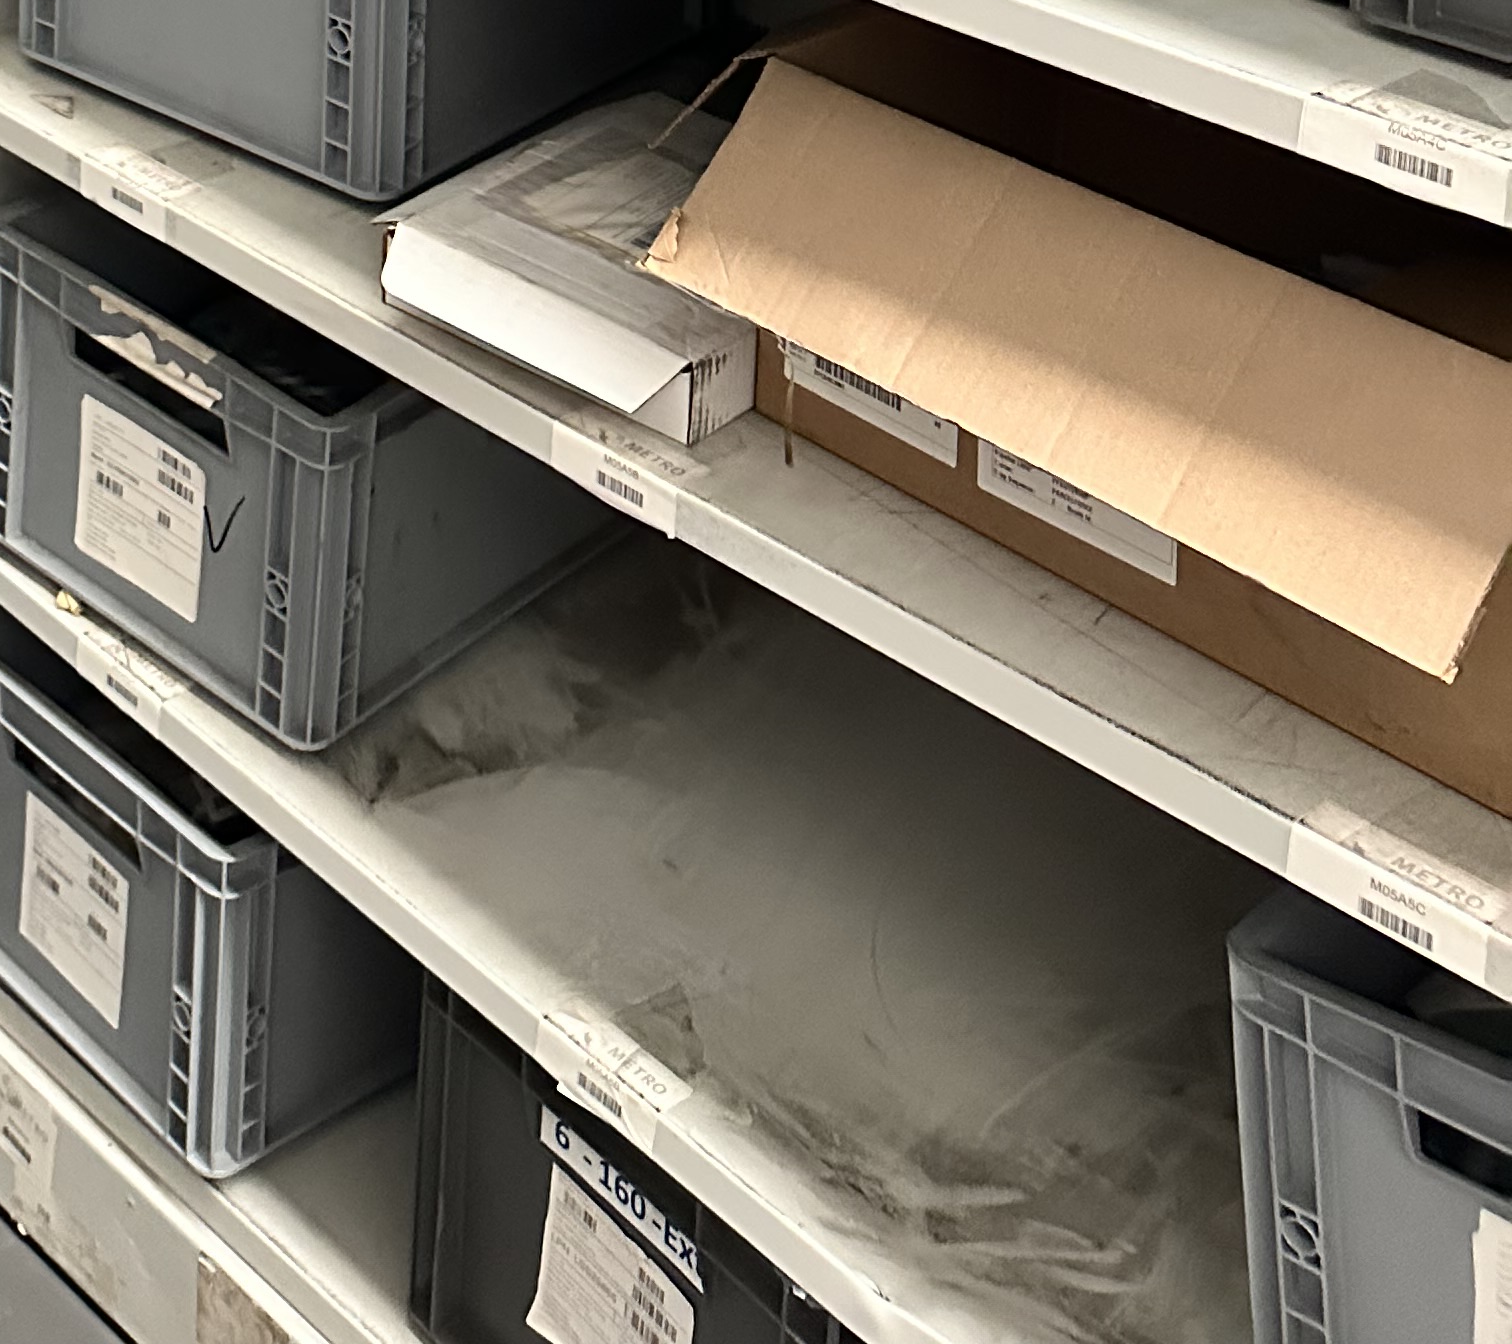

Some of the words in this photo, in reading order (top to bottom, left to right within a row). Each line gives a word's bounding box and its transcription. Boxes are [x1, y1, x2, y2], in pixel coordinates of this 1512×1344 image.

[1414, 114, 1512, 150] METRO
[624, 441, 687, 477] METRO
[1369, 876, 1428, 917] M05A5C
[1389, 856, 1486, 910] METRO
[607, 1045, 668, 1095] METRO
[554, 1118, 570, 1150] 6
